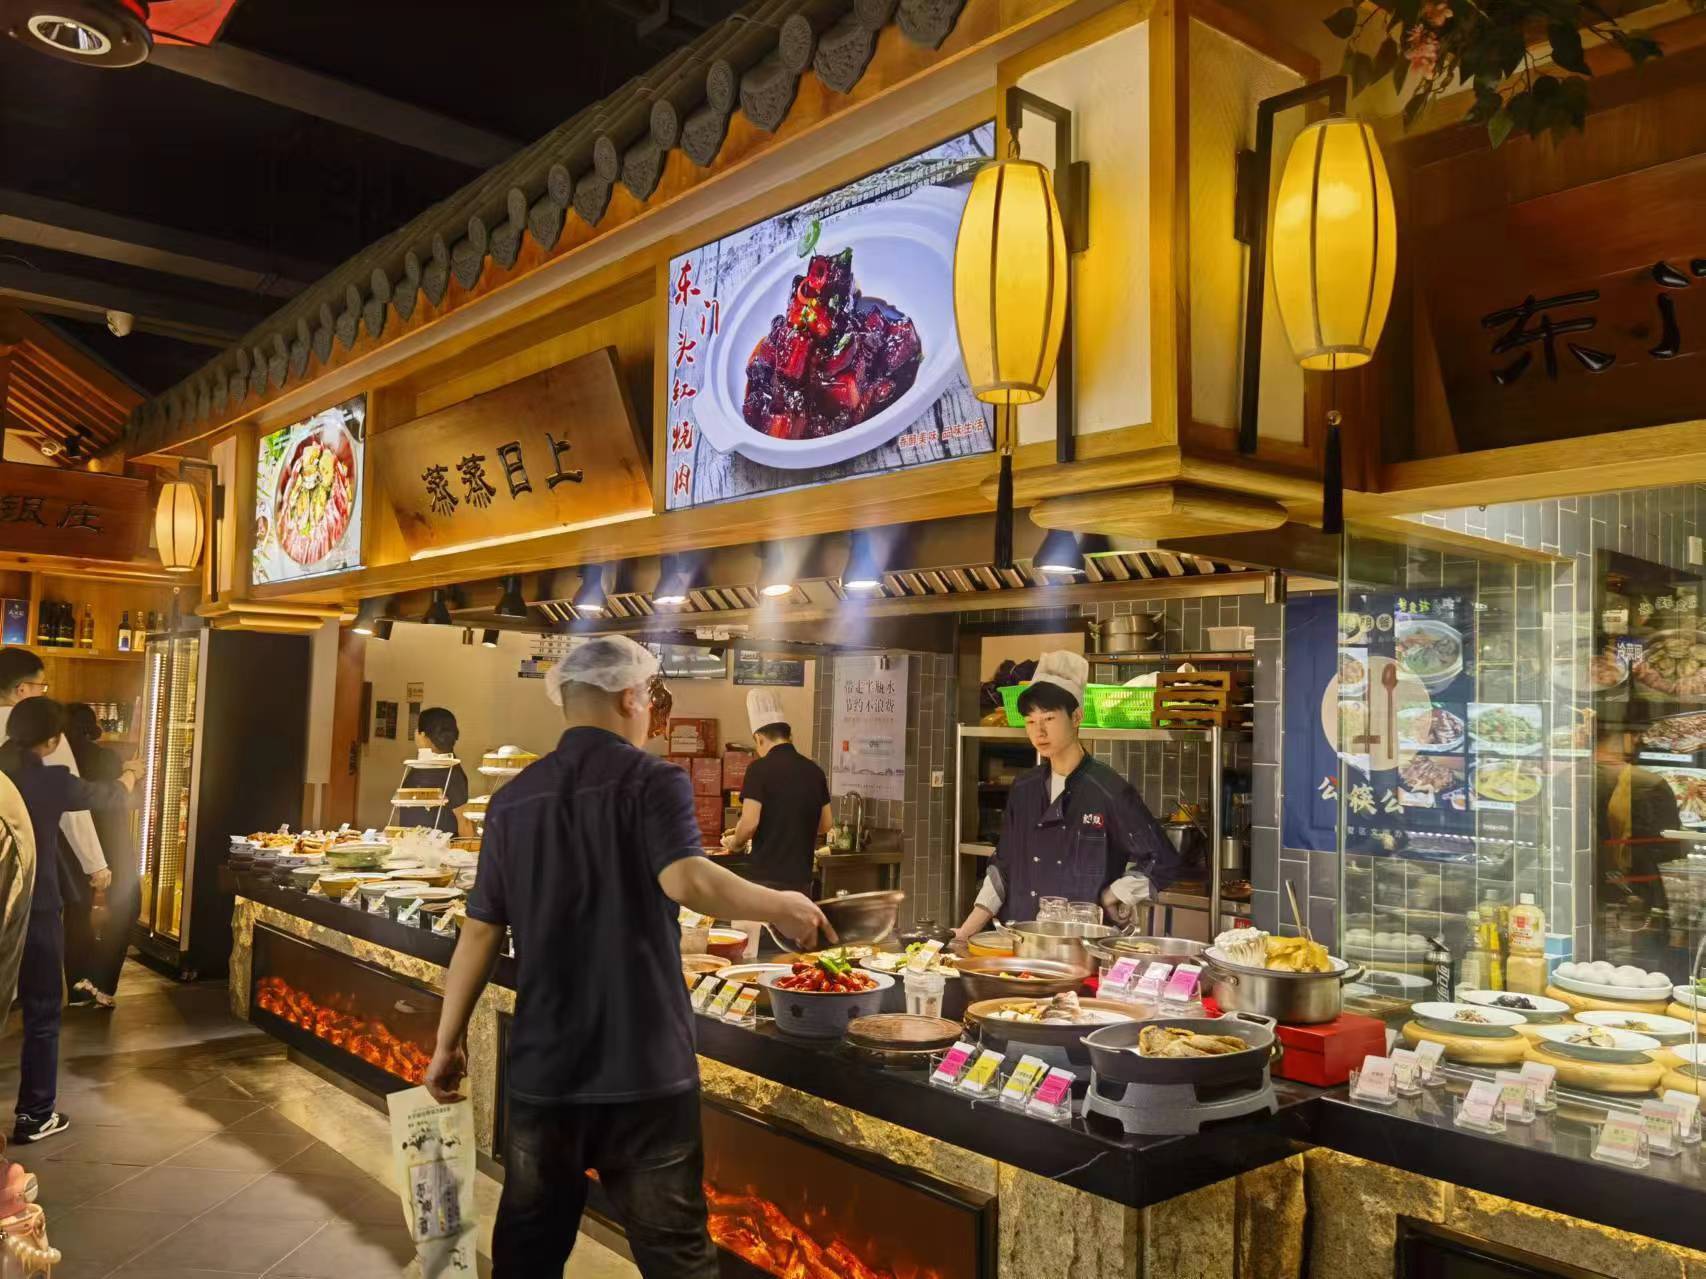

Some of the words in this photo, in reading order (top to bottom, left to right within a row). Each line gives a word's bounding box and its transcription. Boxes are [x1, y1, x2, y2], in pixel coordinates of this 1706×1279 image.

[421, 431, 584, 518] 蒸蒸日上
[845, 697, 896, 713] 节约不浪费
